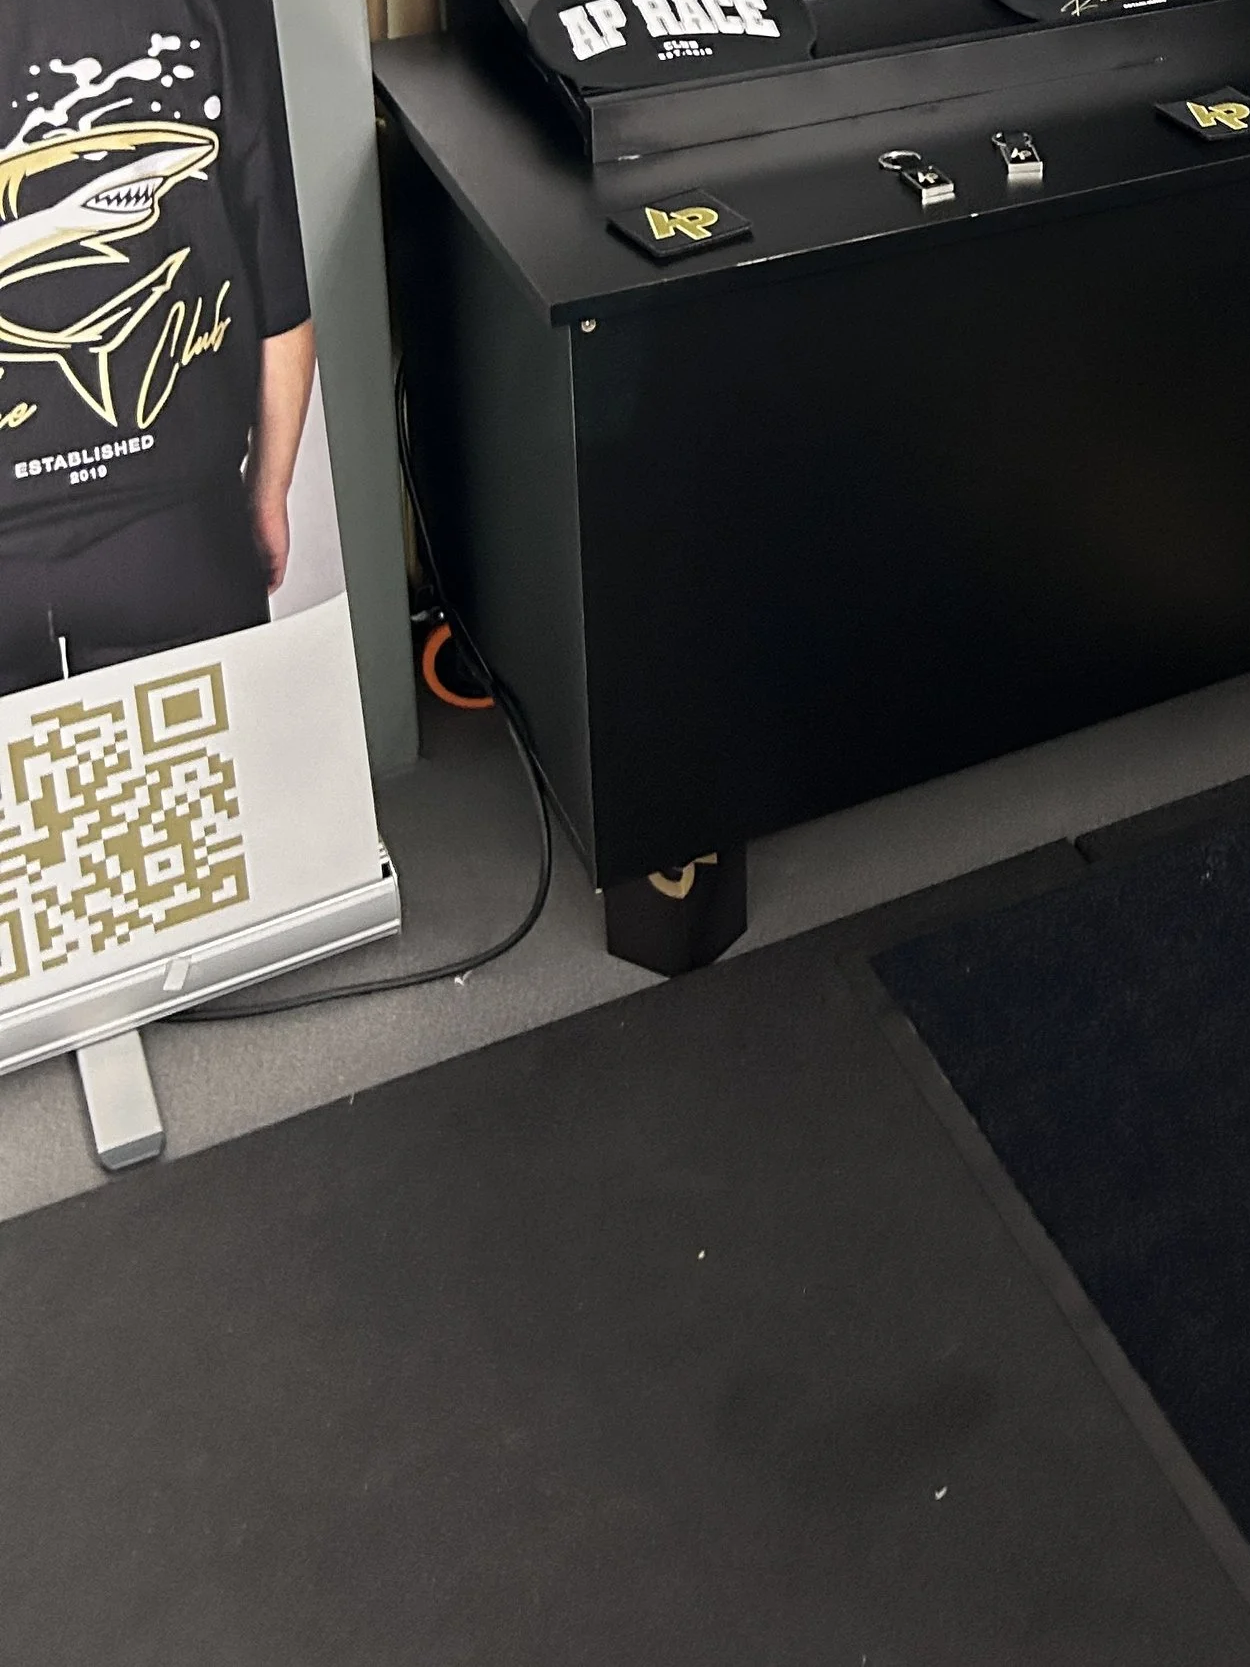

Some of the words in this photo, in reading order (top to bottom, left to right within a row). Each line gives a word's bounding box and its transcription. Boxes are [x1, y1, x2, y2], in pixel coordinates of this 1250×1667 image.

[1186, 101, 1250, 130] AP
[645, 206, 719, 240] AP
[14, 434, 155, 479] ESTABLISHED
[69, 464, 108, 485] 2019
